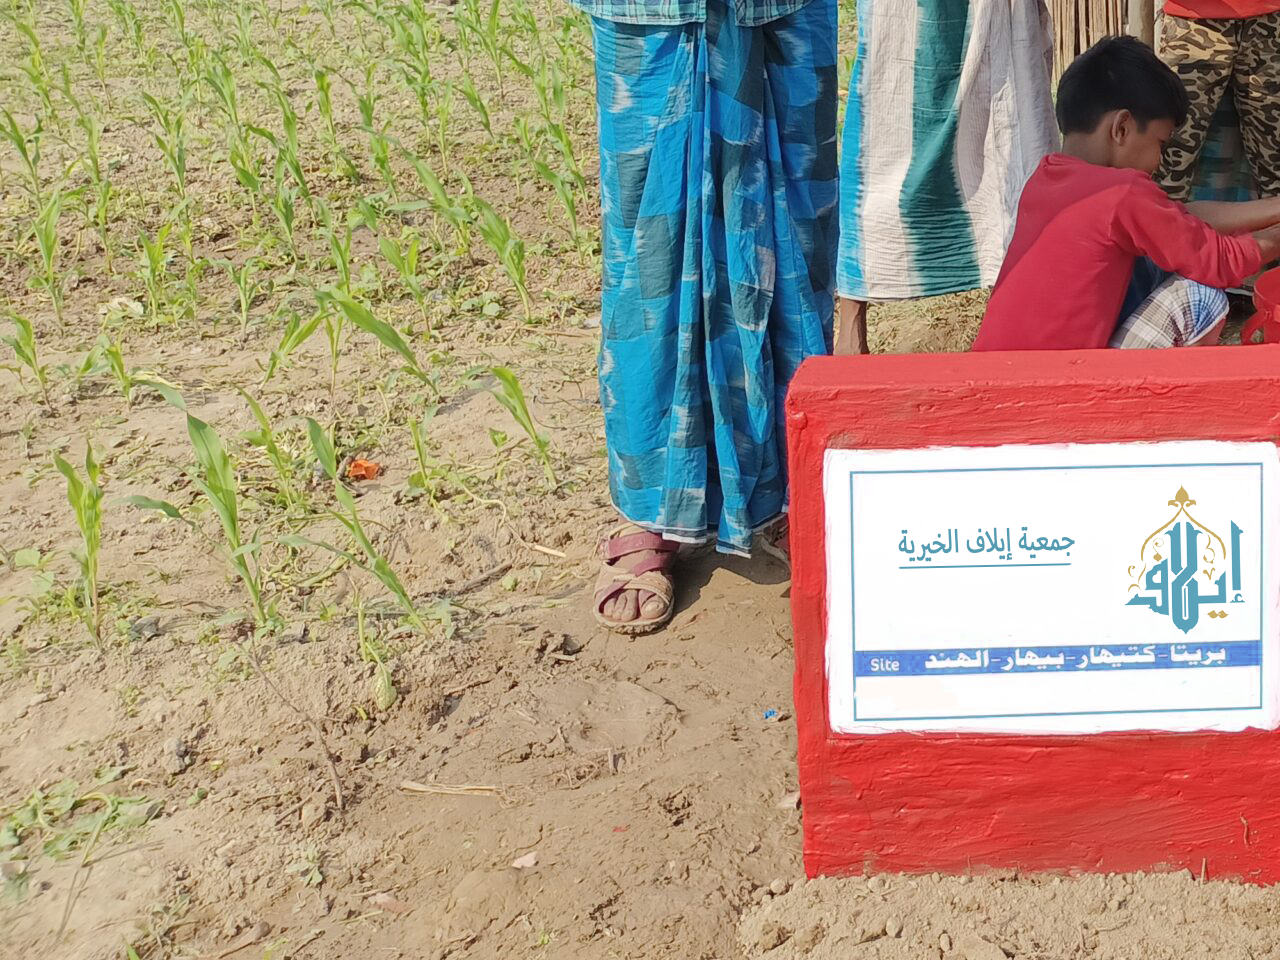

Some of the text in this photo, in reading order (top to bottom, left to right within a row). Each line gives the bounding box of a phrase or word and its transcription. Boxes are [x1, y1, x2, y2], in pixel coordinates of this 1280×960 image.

[898, 526, 1076, 563] جمعية إيلاف الخيرية
[869, 656, 901, 673] Site
